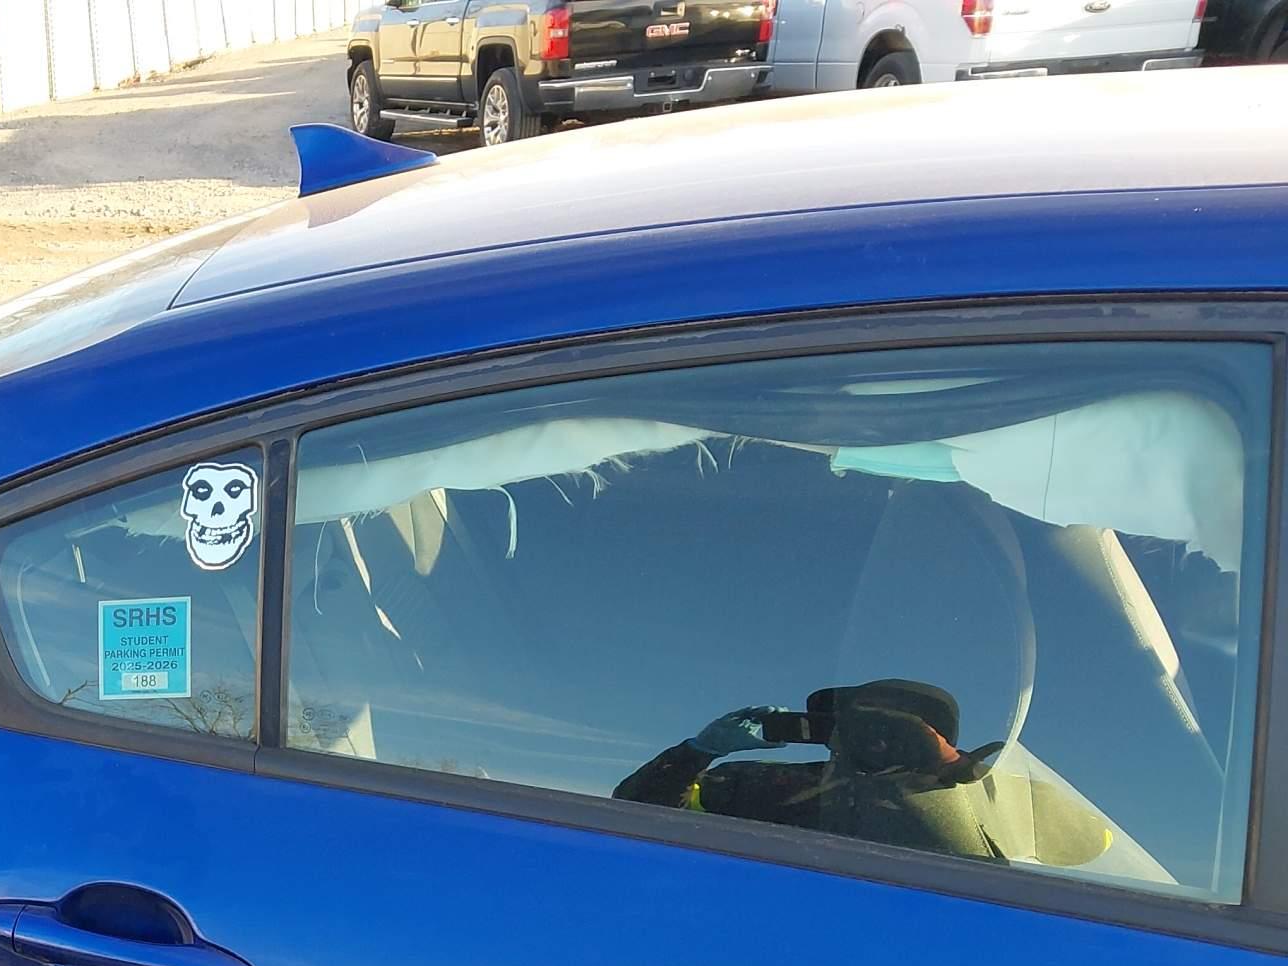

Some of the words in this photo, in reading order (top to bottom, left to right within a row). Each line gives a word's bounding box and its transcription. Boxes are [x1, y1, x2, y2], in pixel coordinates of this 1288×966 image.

[645, 22, 690, 38] GMC
[113, 606, 177, 628] SRHS
[120, 635, 169, 647] STUDENT
[104, 648, 147, 660] PARKING
[149, 647, 185, 658] PERMIT
[111, 660, 178, 672] 2025-2026
[133, 674, 157, 688] 188
